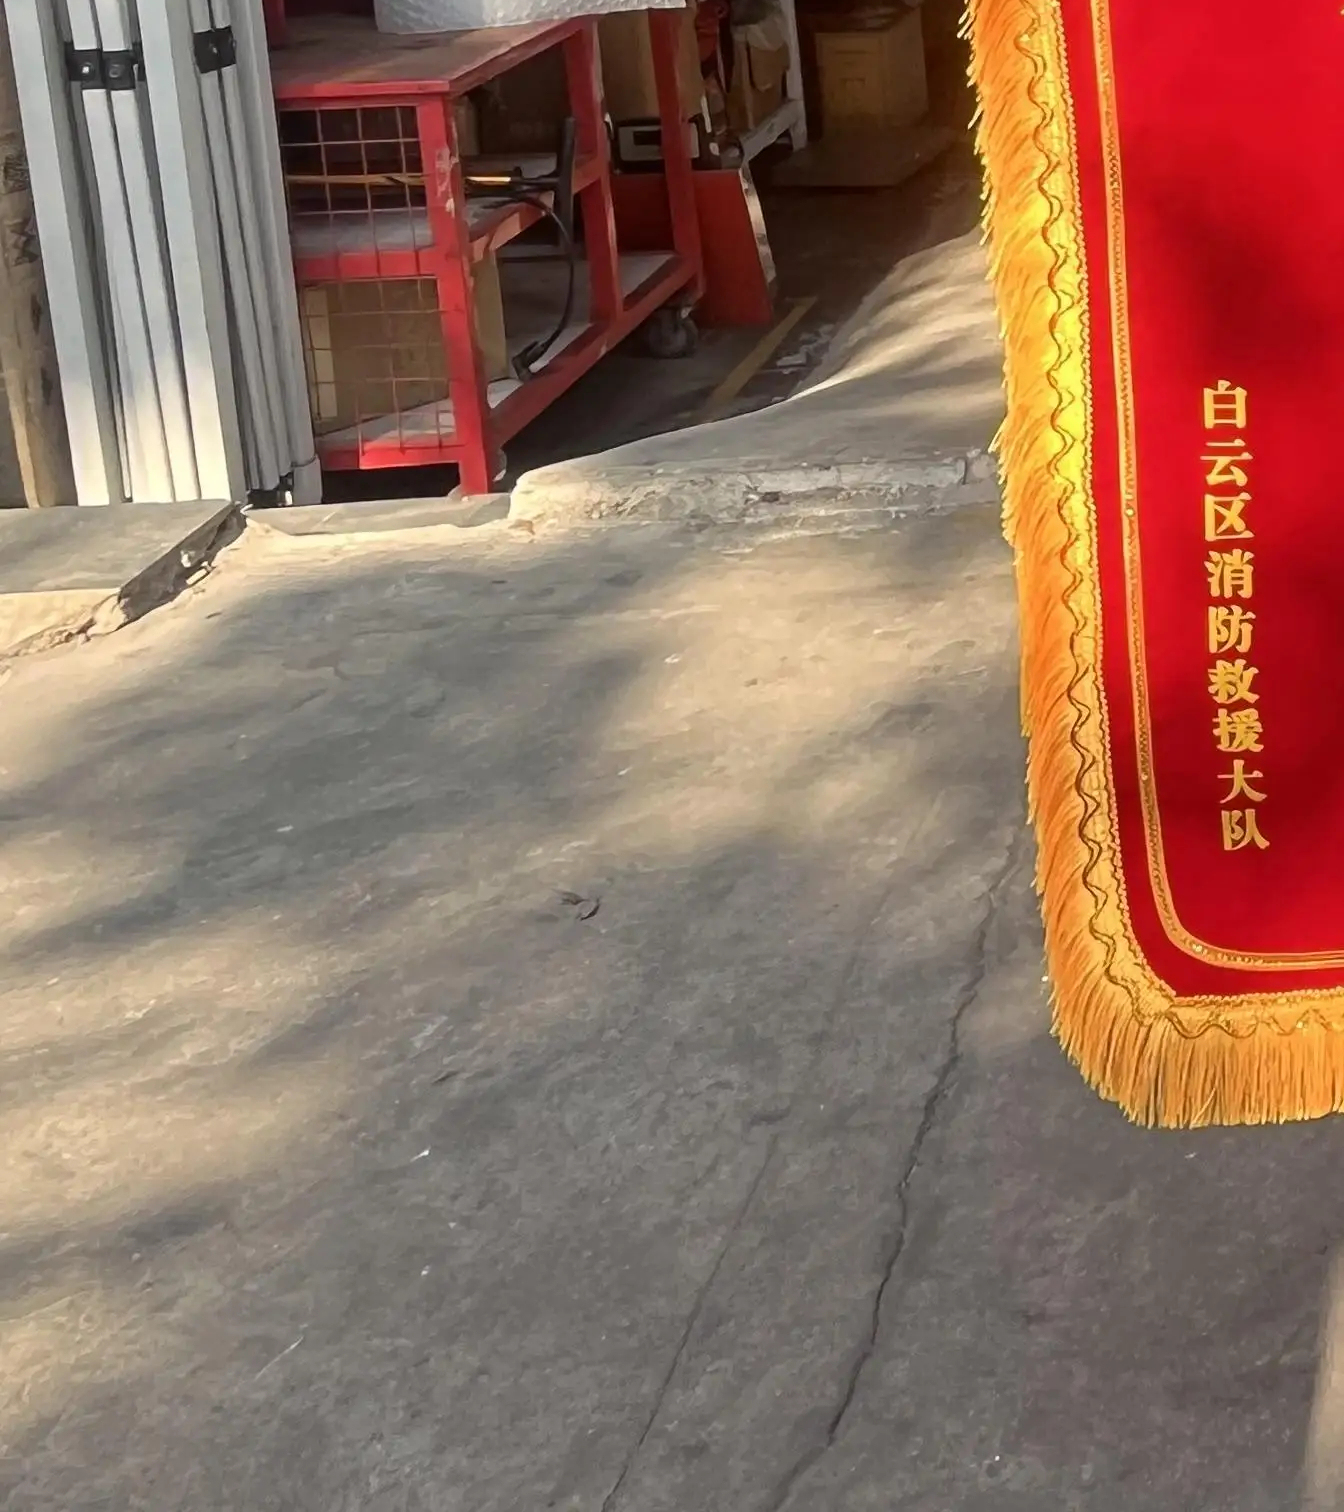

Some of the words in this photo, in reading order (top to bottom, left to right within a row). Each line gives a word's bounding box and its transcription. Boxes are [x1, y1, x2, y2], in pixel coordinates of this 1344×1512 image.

[1200, 378, 1270, 853] 白云区消防救援大队
